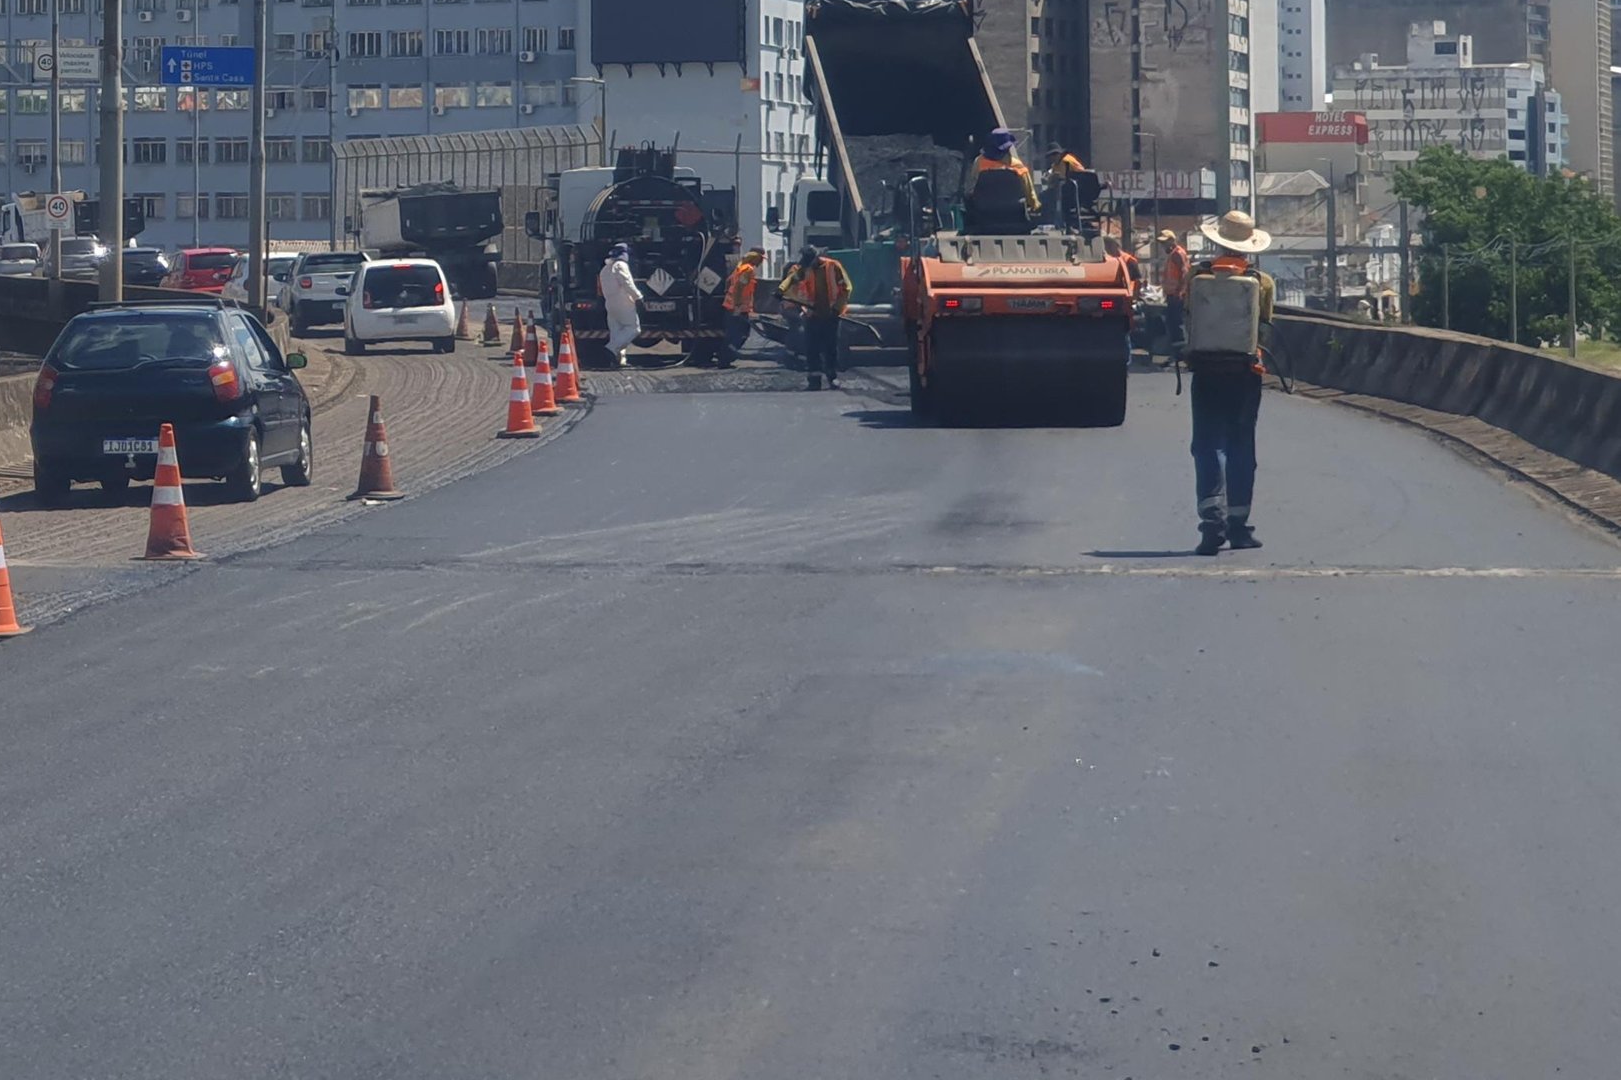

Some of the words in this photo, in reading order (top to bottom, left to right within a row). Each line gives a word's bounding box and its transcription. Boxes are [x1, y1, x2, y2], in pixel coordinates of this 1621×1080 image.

[181, 49, 208, 59] Túnel
[41, 58, 52, 66] 40
[193, 62, 214, 71] HPS
[193, 73, 220, 82] Santa
[221, 73, 245, 82] Casa
[1314, 110, 1347, 123] HOTEL
[1308, 125, 1354, 136] EXPRESS
[52, 201, 65, 211] 40
[992, 267, 1069, 275] PLANATERRA
